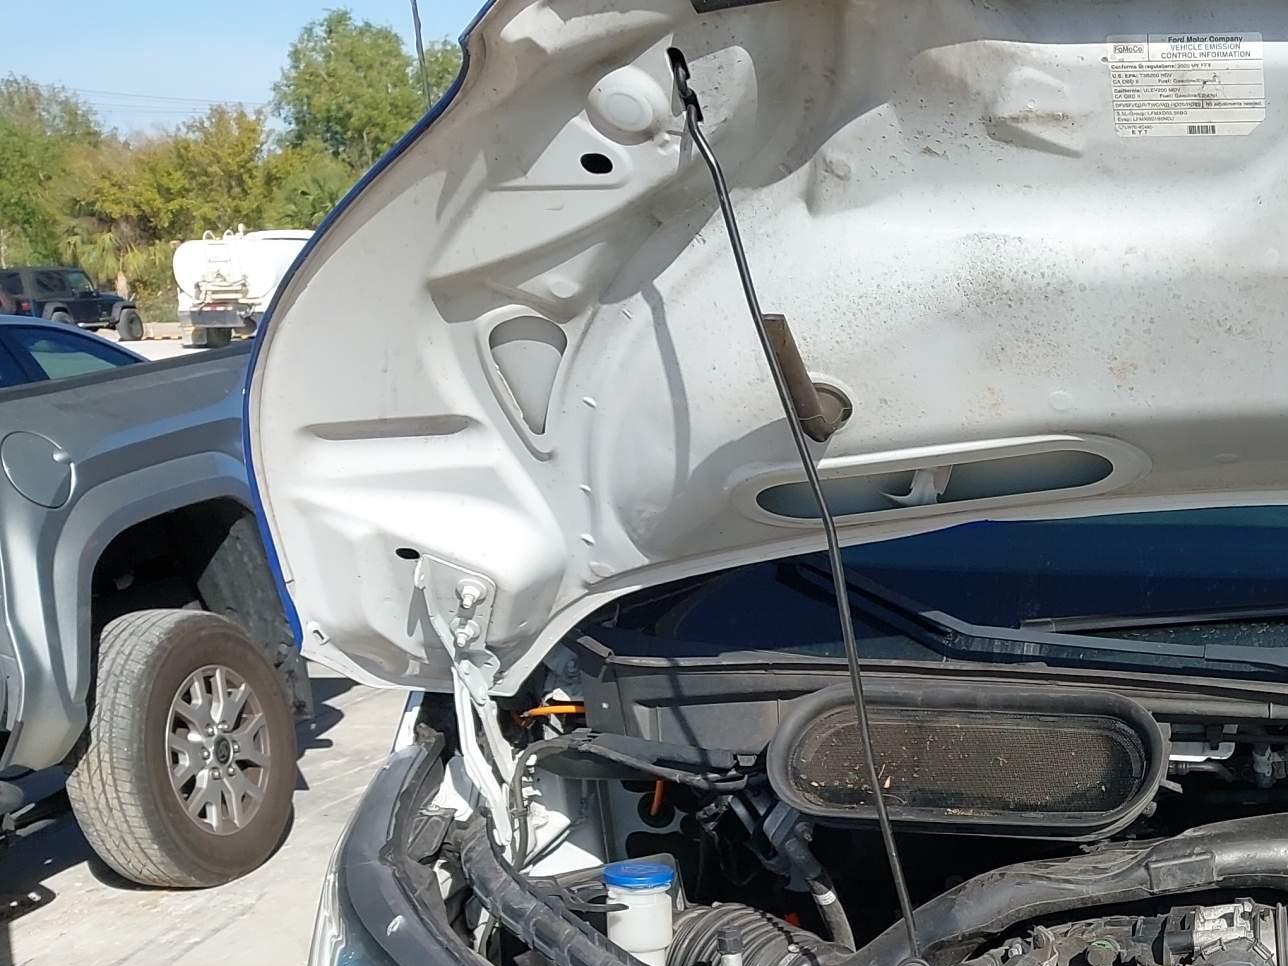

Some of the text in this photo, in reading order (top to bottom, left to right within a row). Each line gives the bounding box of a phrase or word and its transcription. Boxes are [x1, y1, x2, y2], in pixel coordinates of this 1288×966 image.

[1209, 35, 1244, 43] Company
[1113, 45, 1144, 54] FoMoCo
[1170, 43, 1203, 51] VEHICLE
